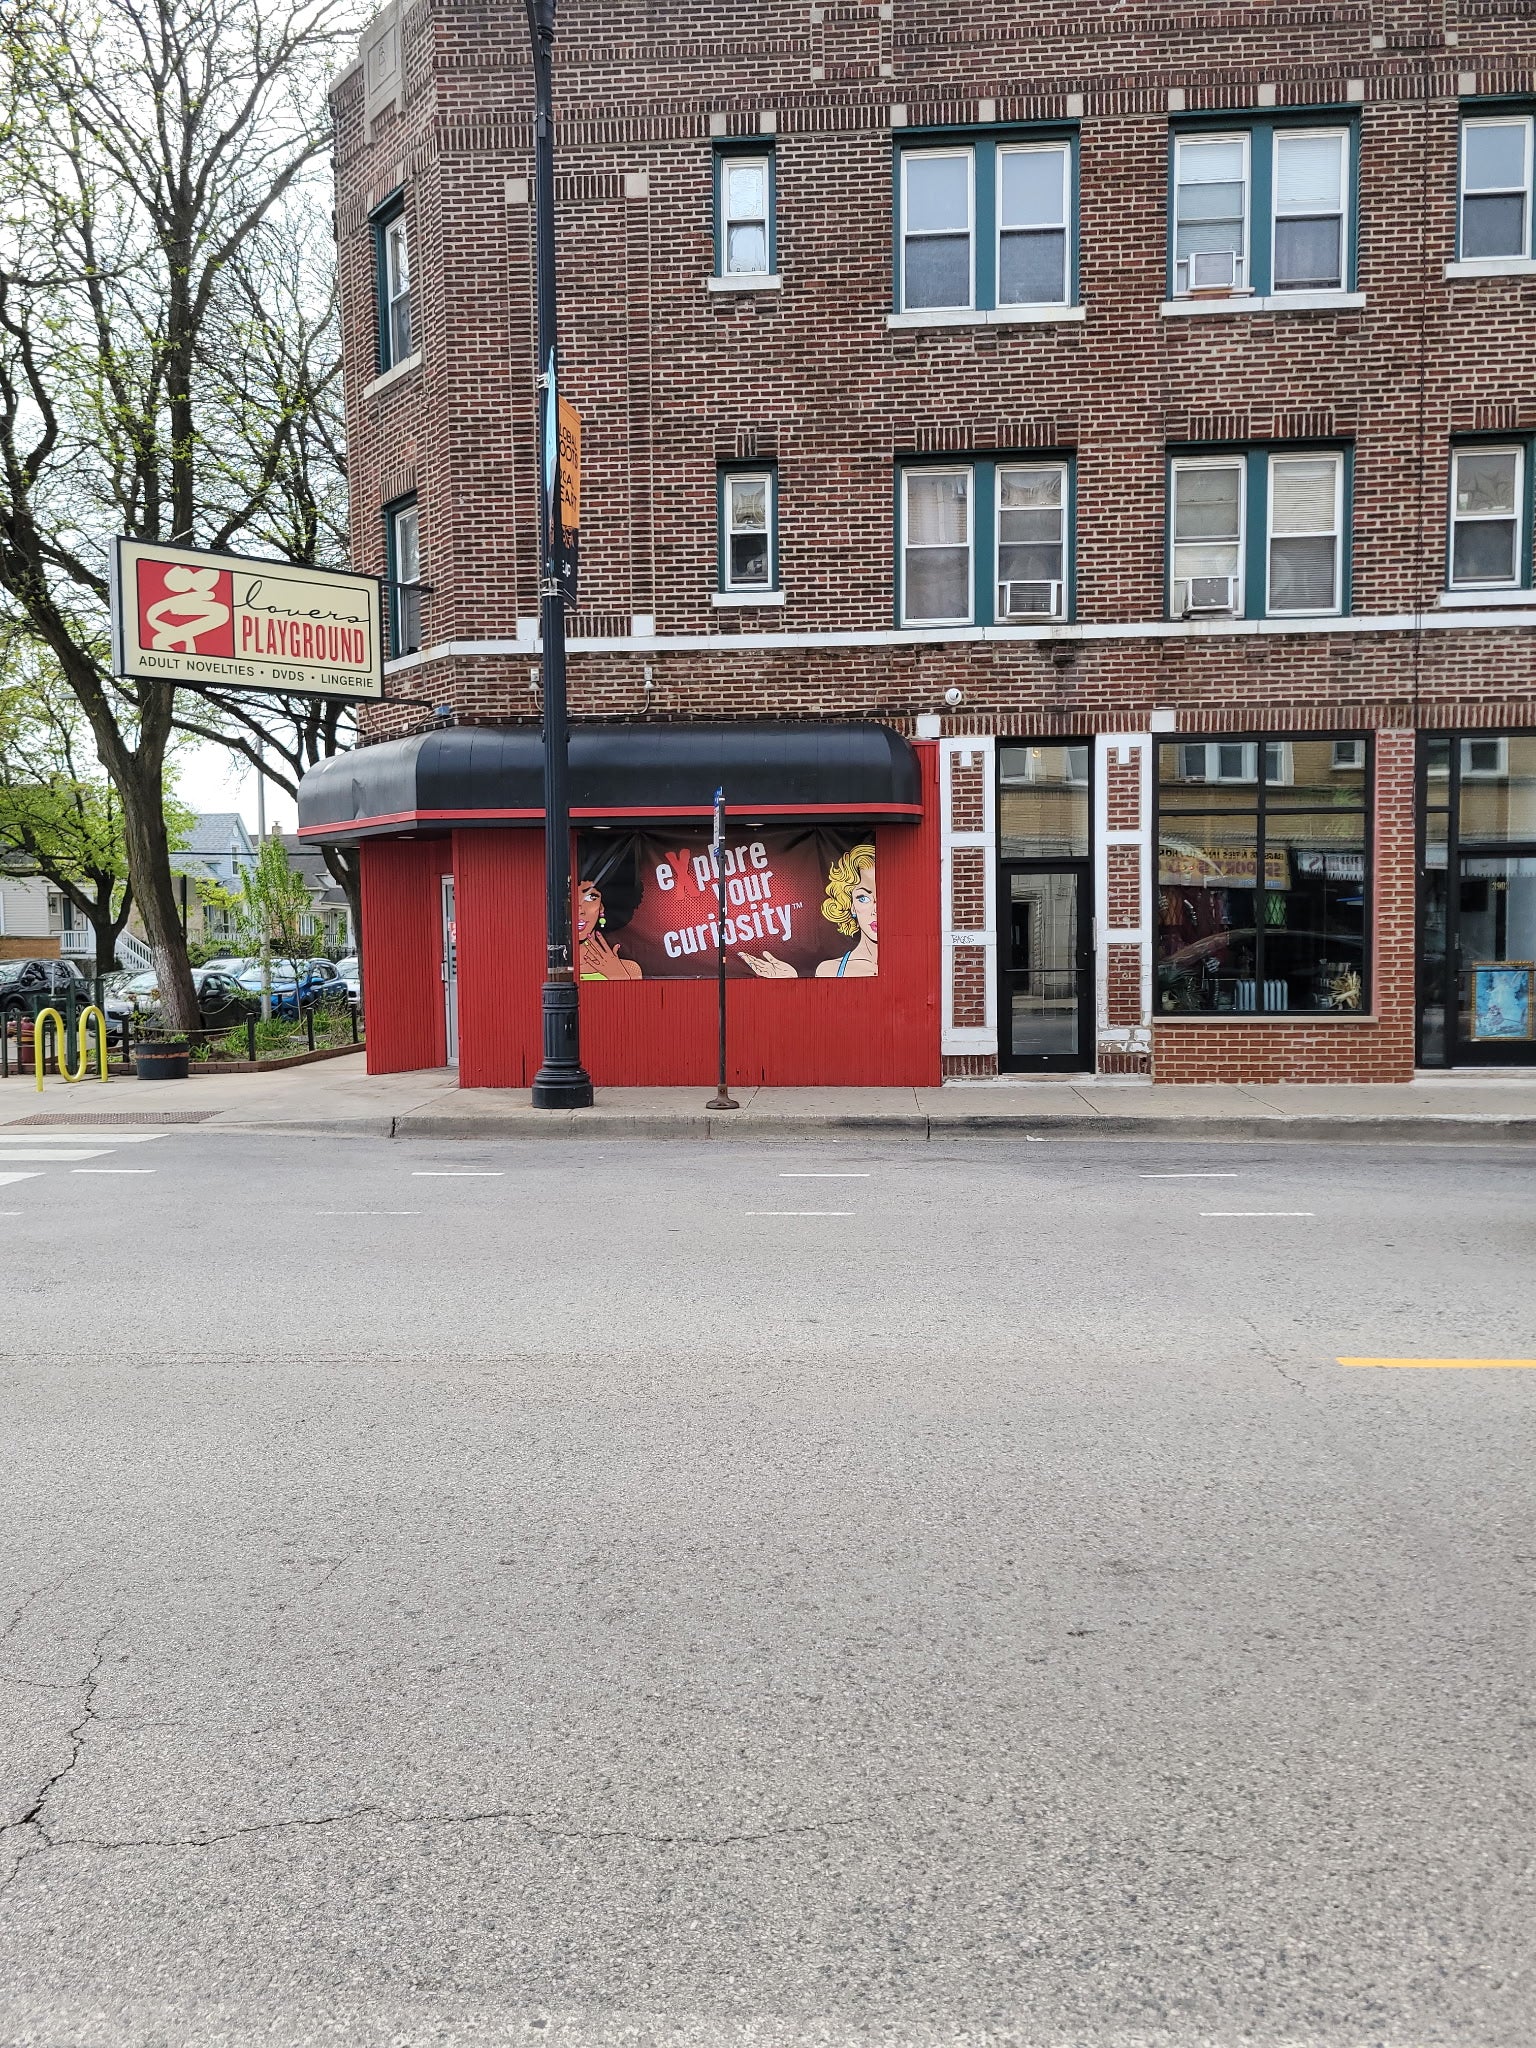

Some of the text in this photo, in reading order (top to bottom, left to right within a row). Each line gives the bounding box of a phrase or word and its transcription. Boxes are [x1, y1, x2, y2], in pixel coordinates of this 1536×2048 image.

[559, 423, 577, 451] LOBAL
[559, 440, 578, 470] OOTS
[233, 579, 370, 624] lovers
[242, 615, 365, 664] PLAYGROUND
[139, 655, 374, 688] ADULT NOVELTIES DVDS LINGERIE
